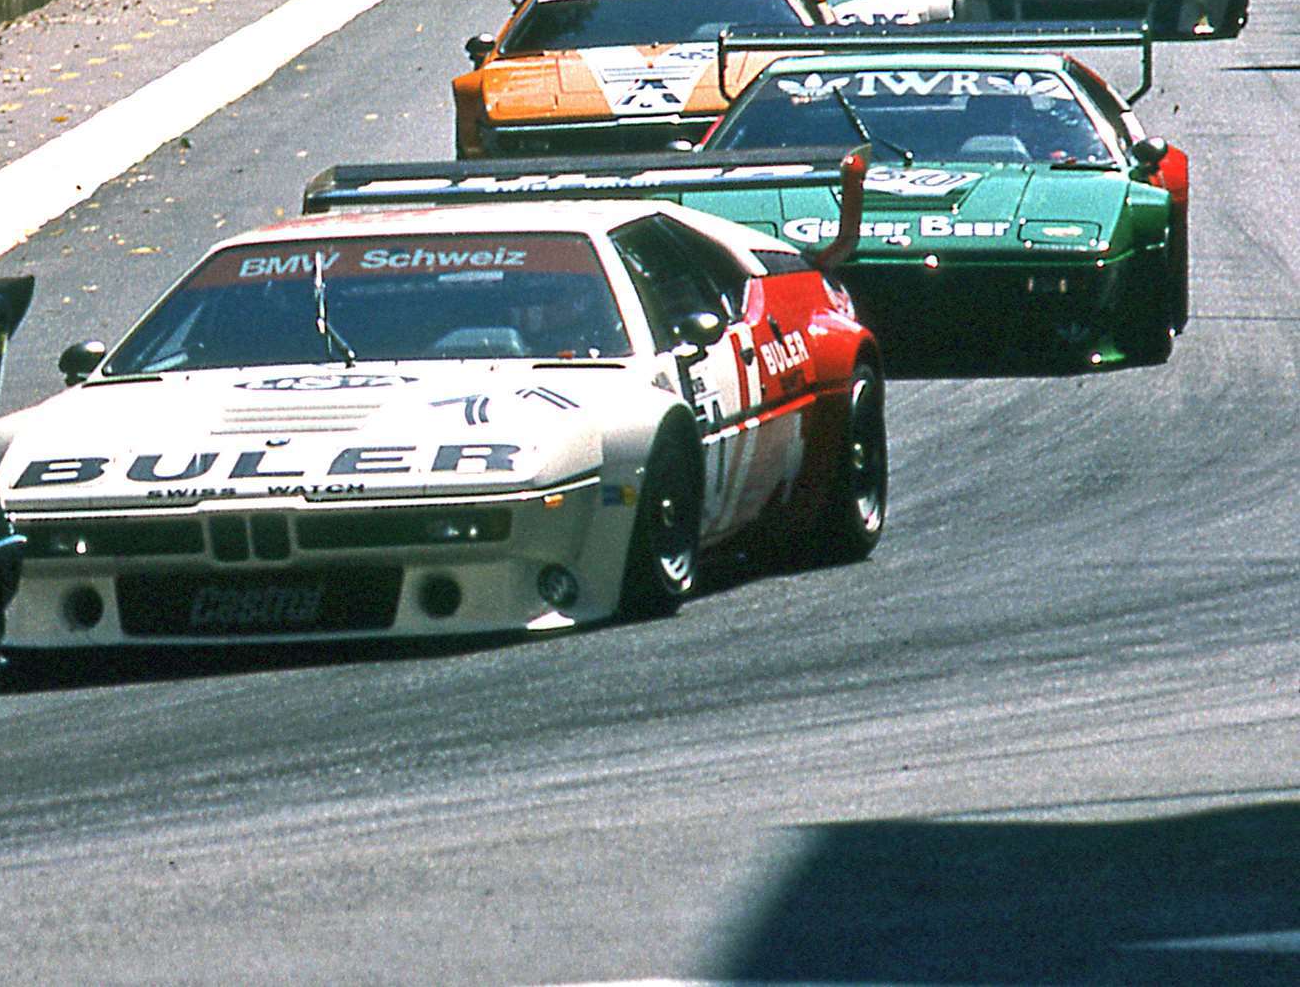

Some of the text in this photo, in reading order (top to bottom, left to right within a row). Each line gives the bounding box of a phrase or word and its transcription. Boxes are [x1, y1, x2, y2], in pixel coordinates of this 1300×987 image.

[855, 71, 982, 96] TWR
[239, 247, 527, 278] BMW Schweiz
[760, 330, 810, 376] BULER
[11, 444, 521, 489] BULER
[146, 482, 368, 501] SWISS WATCH
